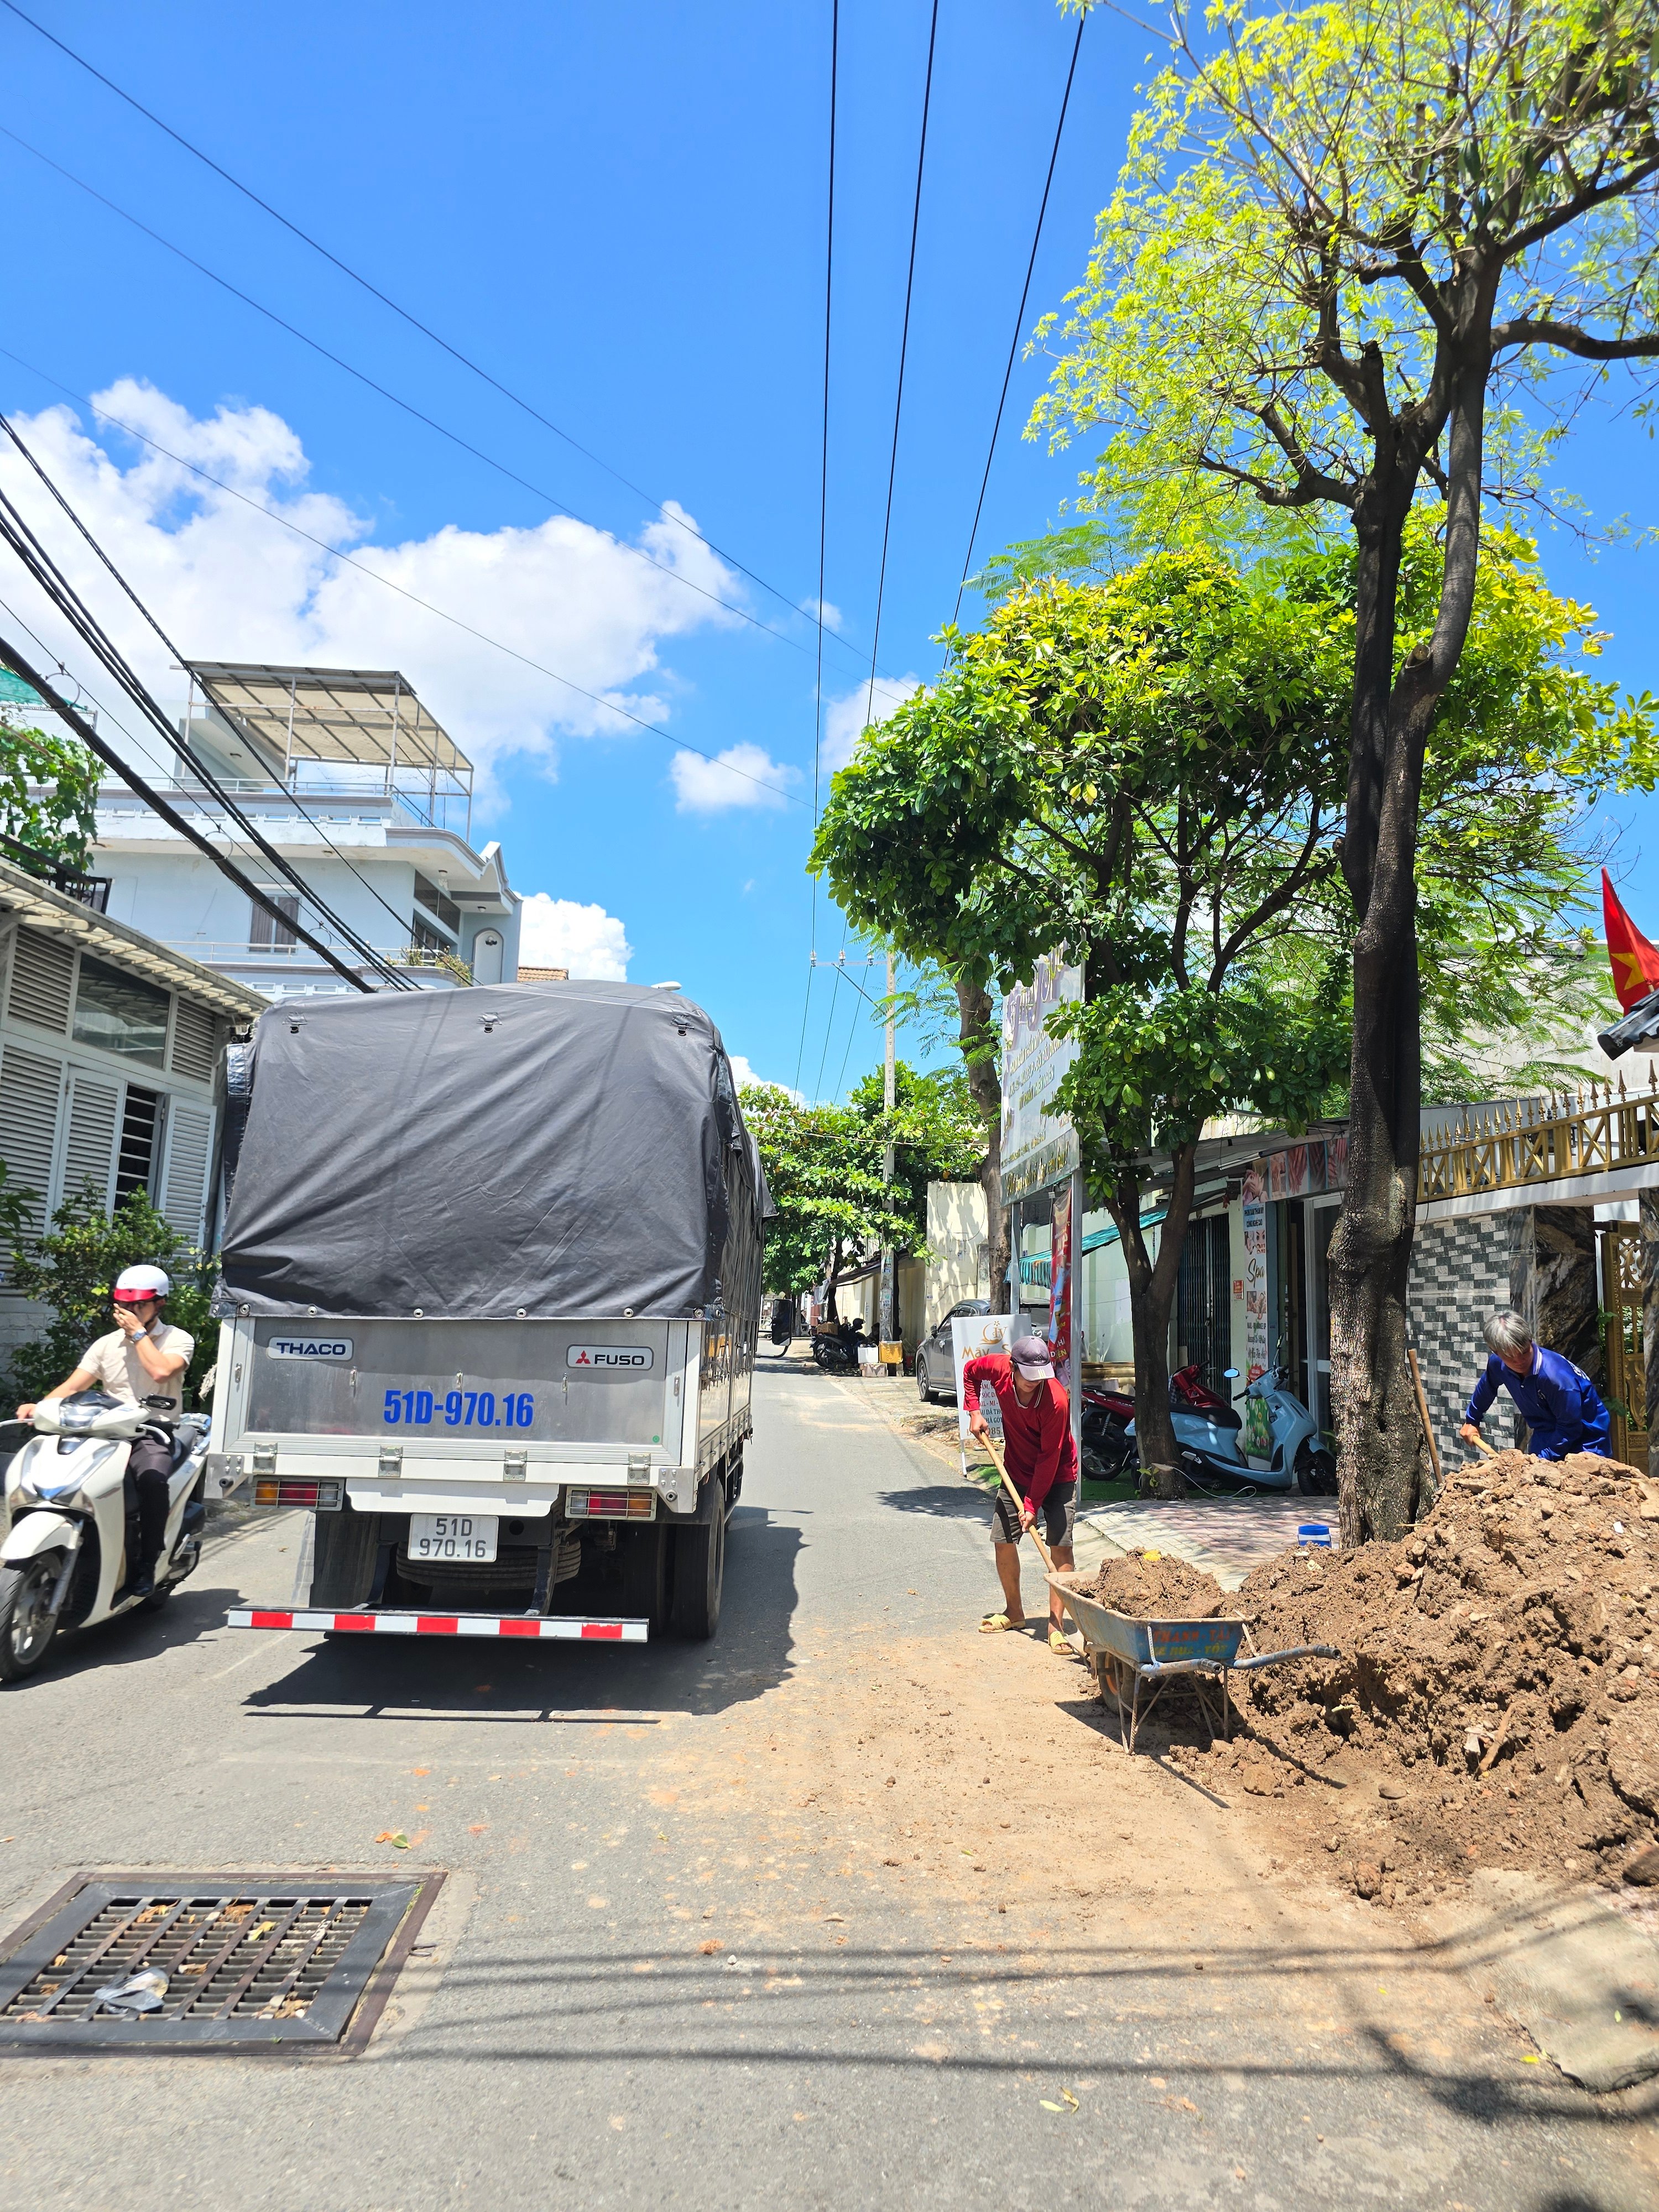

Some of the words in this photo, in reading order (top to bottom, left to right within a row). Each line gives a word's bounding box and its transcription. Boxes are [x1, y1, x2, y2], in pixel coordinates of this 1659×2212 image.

[1246, 1258, 1265, 1288] Spa
[276, 1342, 346, 1355] THACO
[594, 1354, 645, 1365] FUSO
[384, 1390, 534, 1427] 51D-970.16
[436, 1517, 473, 1536] 51D
[419, 1538, 487, 1557] 970.16
